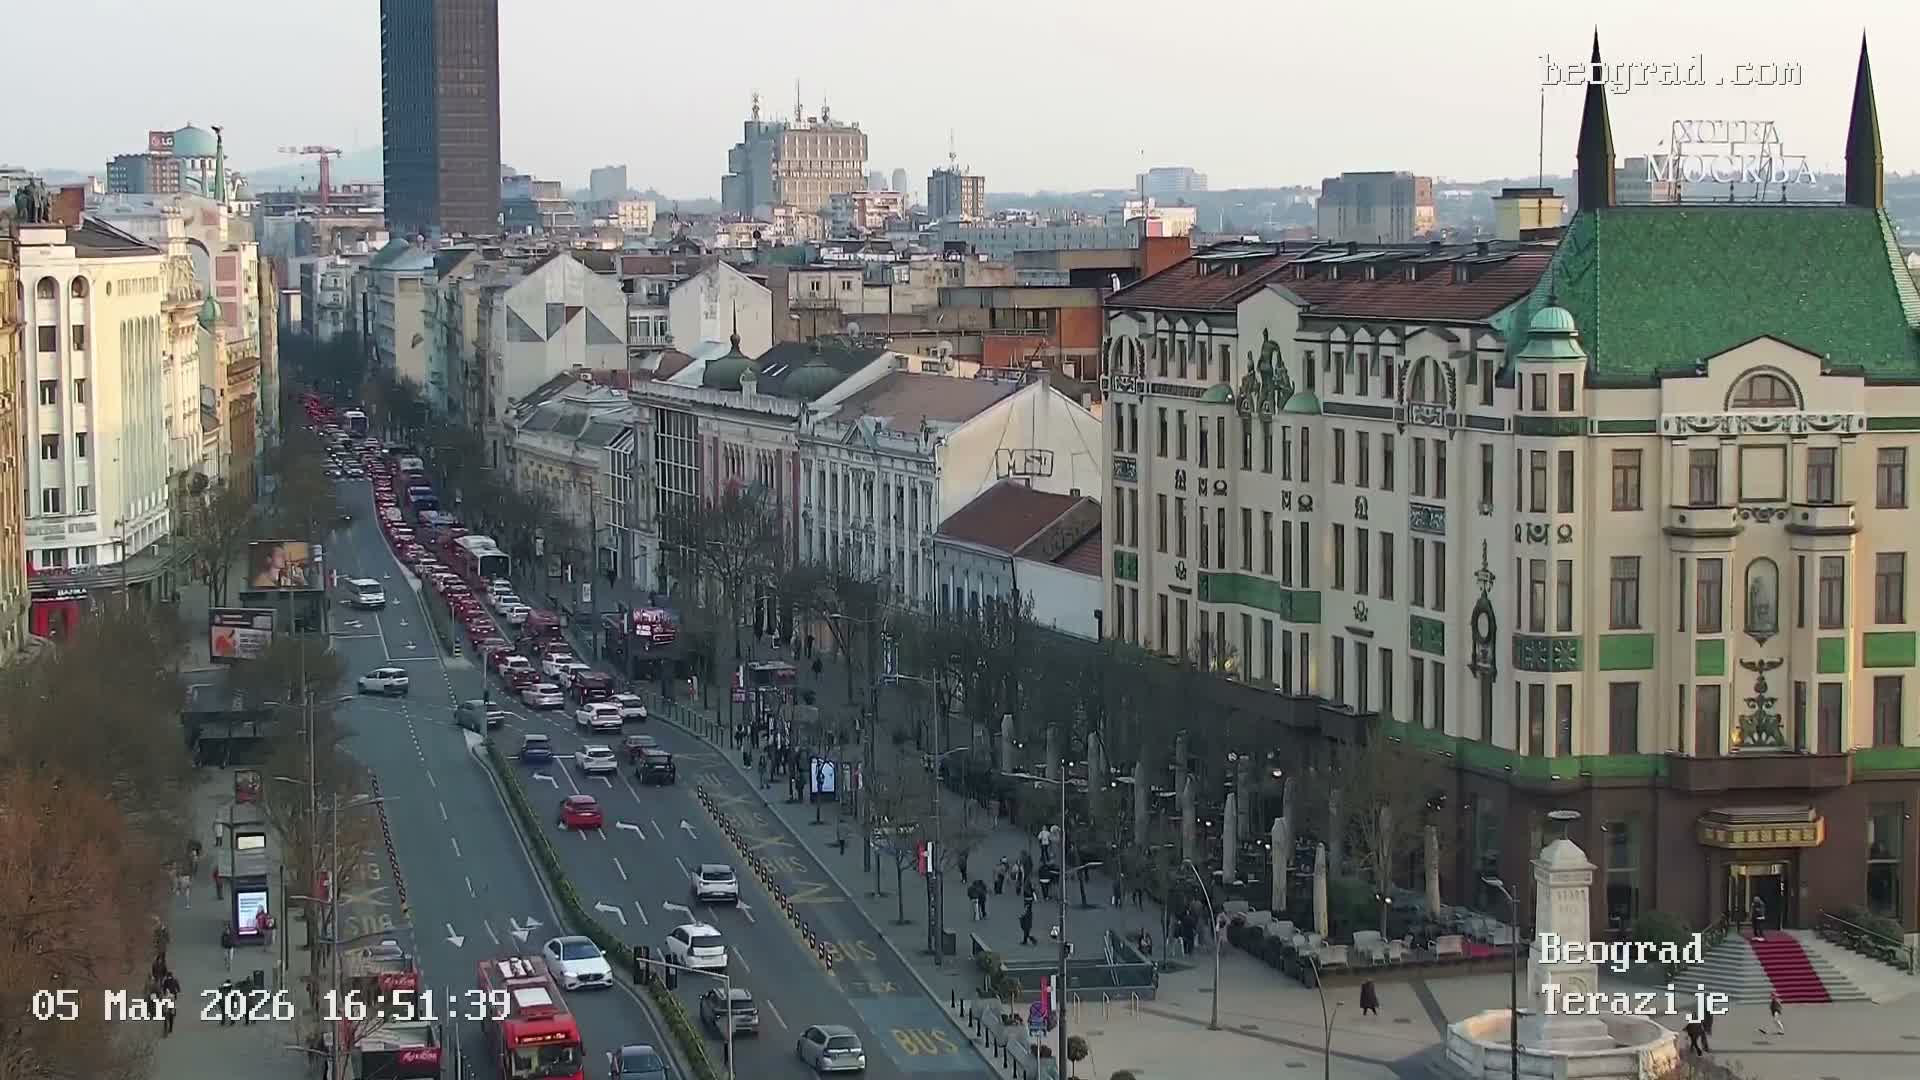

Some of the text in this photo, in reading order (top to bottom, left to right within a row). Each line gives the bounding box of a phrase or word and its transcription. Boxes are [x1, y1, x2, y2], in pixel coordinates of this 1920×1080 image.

[161, 136, 174, 147] LG
[1645, 155, 1816, 185] МОСКВА
[893, 1028, 958, 1056] BUS
